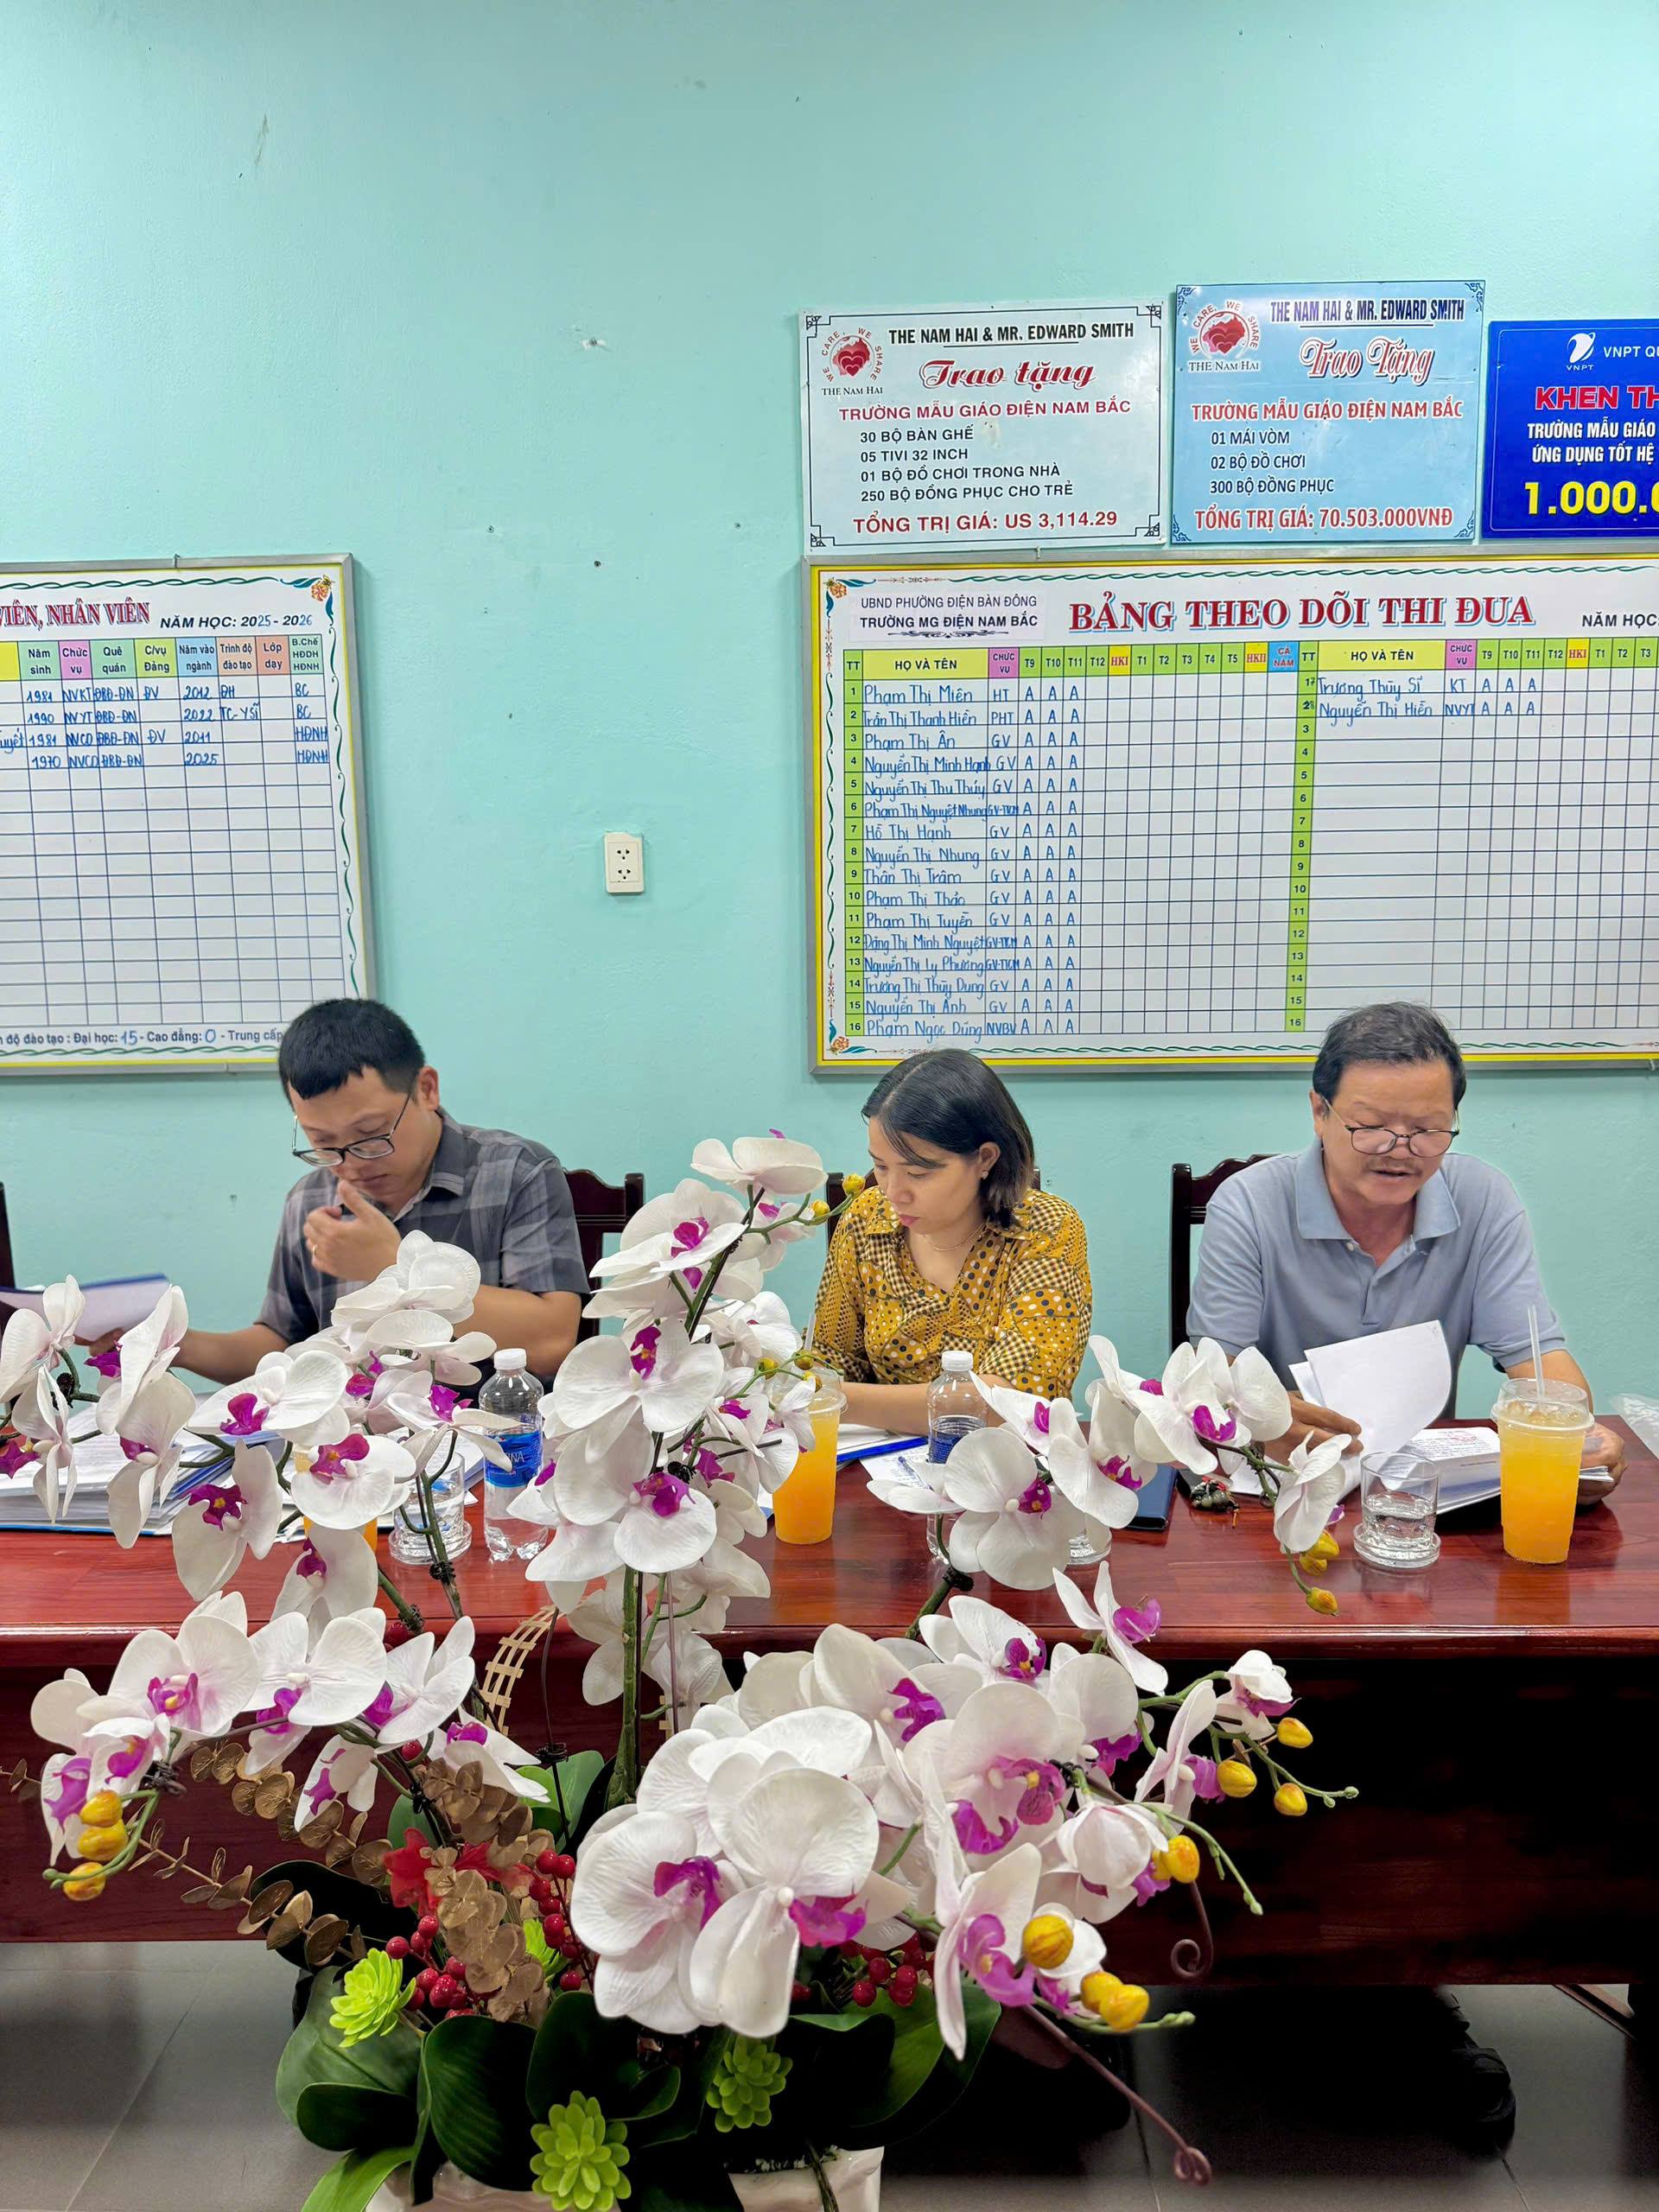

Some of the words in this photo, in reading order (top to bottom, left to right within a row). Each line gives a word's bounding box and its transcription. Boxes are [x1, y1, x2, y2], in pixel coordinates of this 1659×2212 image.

[1271, 302, 1290, 321] THE
[1294, 302, 1319, 321] NAM
[1323, 301, 1340, 321] HAI
[1345, 301, 1353, 321] &
[1357, 301, 1376, 321] MR.
[1381, 300, 1426, 320] EDWARD
[1430, 300, 1464, 320] SMITH
[889, 328, 917, 344] THE
[920, 327, 950, 343] NAM
[955, 327, 978, 342] HAI
[982, 327, 993, 341] &
[997, 326, 1023, 341] MR.
[1027, 324, 1086, 340] EDWARD
[1091, 323, 1134, 338] SMITH
[1604, 346, 1641, 358] VNPT
[1189, 361, 1211, 372] THE
[1300, 338, 1363, 378] Trao
[1367, 336, 1435, 385] Tặng
[919, 360, 1006, 389] Trao
[1014, 360, 1096, 392] tặng
[822, 387, 842, 396] THE
[1535, 386, 1619, 410] KHEN
[839, 405, 911, 421] TRƯỜNG
[917, 398, 953, 419] MẪU
[959, 401, 1001, 417] GIÁO
[1007, 400, 1046, 418] ĐIỆN
[1052, 403, 1090, 415] NAM
[1096, 397, 1131, 414] BẮC
[1192, 401, 1258, 420] TRƯỜNG
[1263, 398, 1298, 419] MẪU
[1304, 400, 1342, 419] GIÁO
[1348, 400, 1386, 421] ĐIỆN
[1391, 402, 1426, 418] NAM
[1433, 397, 1463, 417] BẮC
[861, 431, 875, 444] 30
[881, 428, 901, 445] BỘ
[906, 427, 938, 442] BÀN
[943, 423, 974, 441] GHẾ
[1528, 419, 1582, 438] TRƯỜNG
[1587, 416, 1618, 438] MẪU
[1624, 418, 1656, 437] GIÁO
[1211, 432, 1225, 445] 01
[1230, 428, 1255, 445] MÁI
[1260, 428, 1289, 444] VÒM
[861, 451, 876, 463] 05
[881, 450, 907, 462] TIVI
[912, 449, 927, 461] 32
[932, 448, 968, 461] INCH
[1211, 456, 1225, 469] 02
[1230, 454, 1247, 471] BỘ
[1251, 451, 1269, 468] ĐỒ
[1274, 454, 1306, 468] CHƠI
[1533, 444, 1560, 462] ỨNG
[1566, 447, 1604, 466] DỤNG
[1608, 441, 1632, 461] TỐT
[1637, 442, 1654, 465] HỆ
[861, 470, 875, 483] 01
[881, 467, 902, 485] BỘ
[906, 464, 928, 481] ĐỒ
[932, 466, 968, 480] CHƠI
[973, 465, 1024, 480] TRONG
[1029, 462, 1060, 477] NHÀ
[861, 490, 885, 502] 250
[890, 486, 911, 504] BỘ
[914, 484, 957, 500] ĐỒNG
[963, 486, 1003, 501] PHỤC
[1008, 485, 1040, 498] CHO
[1045, 480, 1073, 496] TRẺ
[1211, 480, 1232, 493] 300
[1236, 478, 1254, 496] BỘ
[1258, 475, 1295, 493] ĐỒNG
[1300, 479, 1334, 495] PHỤC
[854, 510, 911, 534] TỔNG
[918, 515, 950, 533] TRỊ
[957, 511, 998, 531] GIÁ:
[1006, 513, 1032, 529] US
[1039, 512, 1117, 530] 3,114.29
[1195, 505, 1241, 529] TỔNG
[1247, 510, 1274, 531] TRỊ
[1279, 505, 1313, 528] GIÁ:
[1319, 508, 1452, 528] 70.503.000VNĐ
[861, 598, 892, 609] UBND
[895, 595, 944, 608] PHƯỜNG
[947, 595, 974, 609] ĐIỆN
[978, 594, 1001, 607] BÀN
[1004, 594, 1036, 607] ĐÔNG
[47, 597, 100, 626] NHÂN
[104, 596, 149, 624] VIÊN
[1068, 591, 1174, 632] BẢNG
[1185, 599, 1290, 630] THEO
[1299, 592, 1370, 626] DÕI
[1378, 596, 1446, 626] THI
[1455, 595, 1536, 626] ĐUA
[161, 616, 194, 628] NĂM
[199, 616, 237, 629] HỌC:
[240, 614, 271, 626] 2025
[283, 614, 313, 626] 2026
[860, 617, 914, 629] TRƯỜNG
[919, 618, 938, 627] MG
[944, 614, 974, 629] ĐIỆN
[978, 616, 1007, 626] NAM
[1011, 612, 1038, 626] BẮC
[1582, 612, 1617, 626] NĂM
[29, 649, 50, 658] Năm
[62, 647, 88, 657] Chức
[104, 645, 122, 656] Quê
[264, 643, 282, 652] Lớp
[993, 652, 1014, 661] CHỨC
[1025, 658, 1034, 668] T9
[1046, 658, 1060, 667] T10
[1068, 658, 1082, 667] T11
[30, 665, 51, 674] sinh
[71, 665, 82, 675] vụ
[103, 663, 125, 673] quán
[265, 660, 282, 670] dạy
[895, 661, 911, 671] HỌ
[915, 658, 930, 670] VÀ
[934, 658, 957, 670] TÊN
[1000, 665, 1009, 674] VỤ
[296, 683, 308, 697] BC
[148, 1032, 168, 1041] Cao
[228, 1030, 260, 1042] Trung
